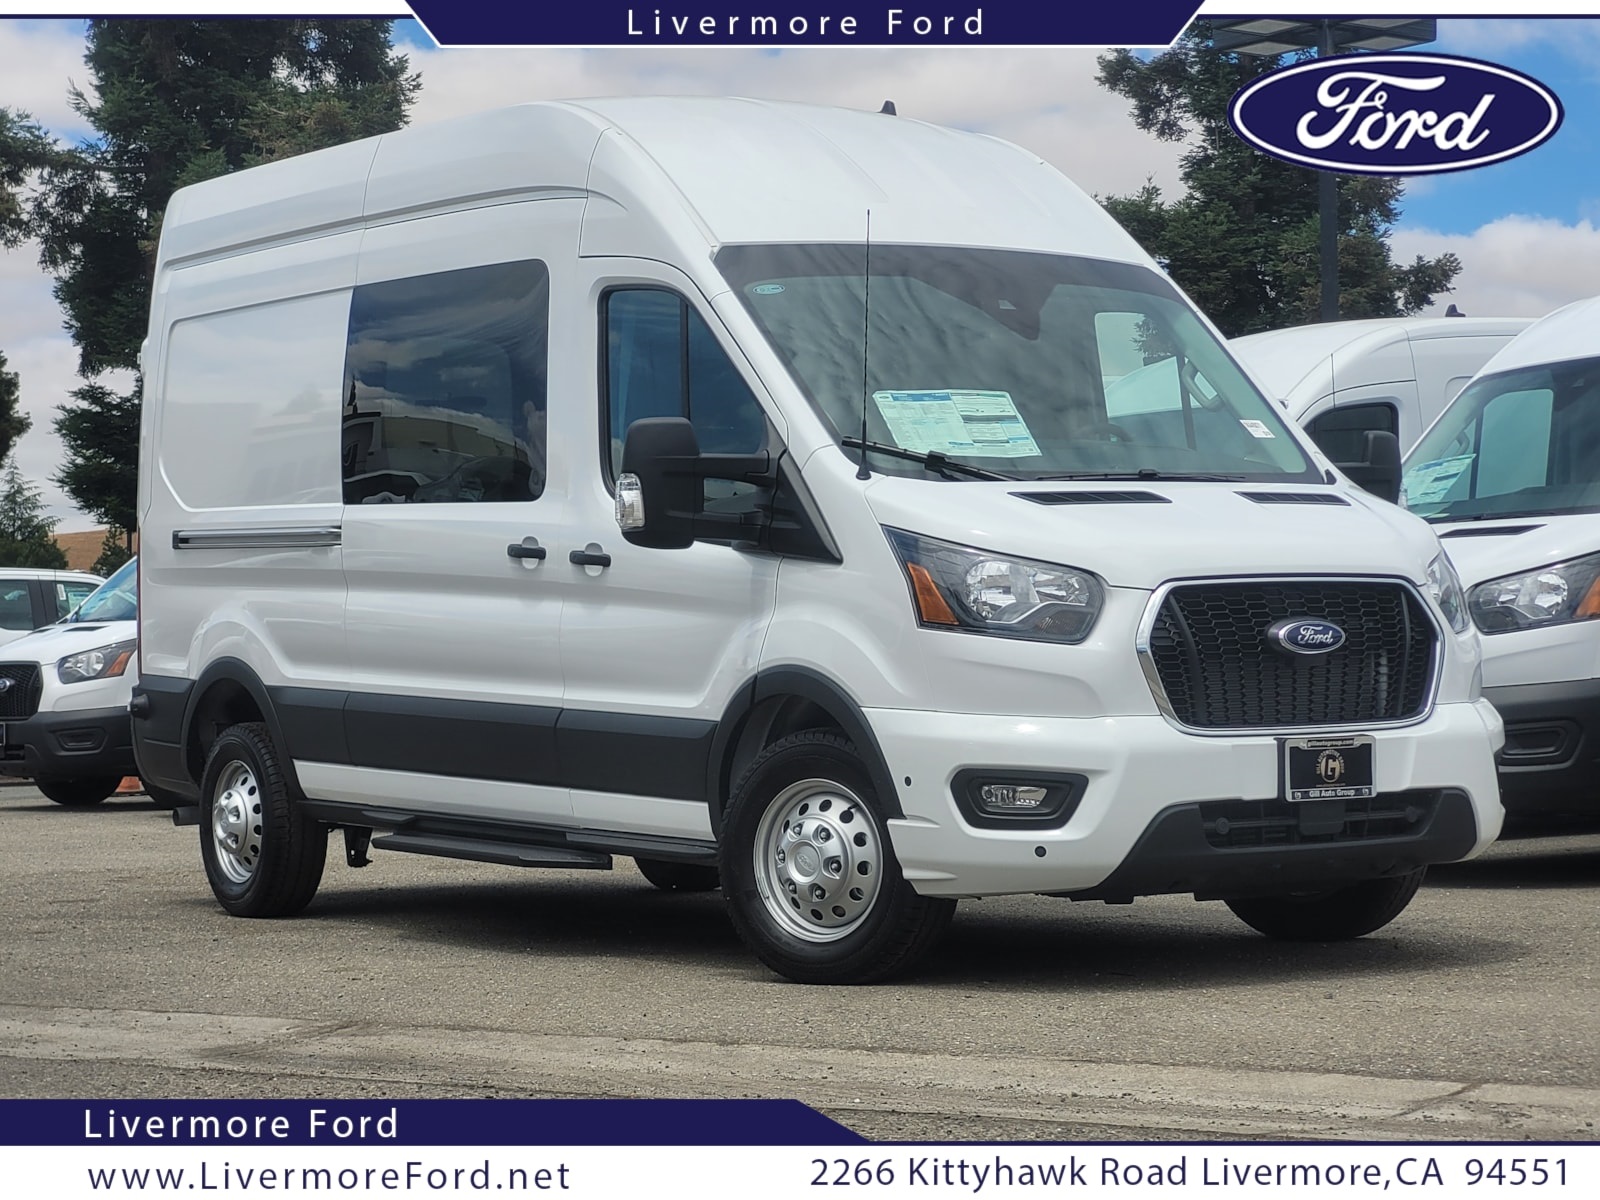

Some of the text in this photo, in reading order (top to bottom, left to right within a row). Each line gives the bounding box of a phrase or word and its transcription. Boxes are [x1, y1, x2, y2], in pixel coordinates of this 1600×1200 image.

[1297, 625, 1334, 645] Ford
[1309, 789, 1355, 798] Gill Auto Group
